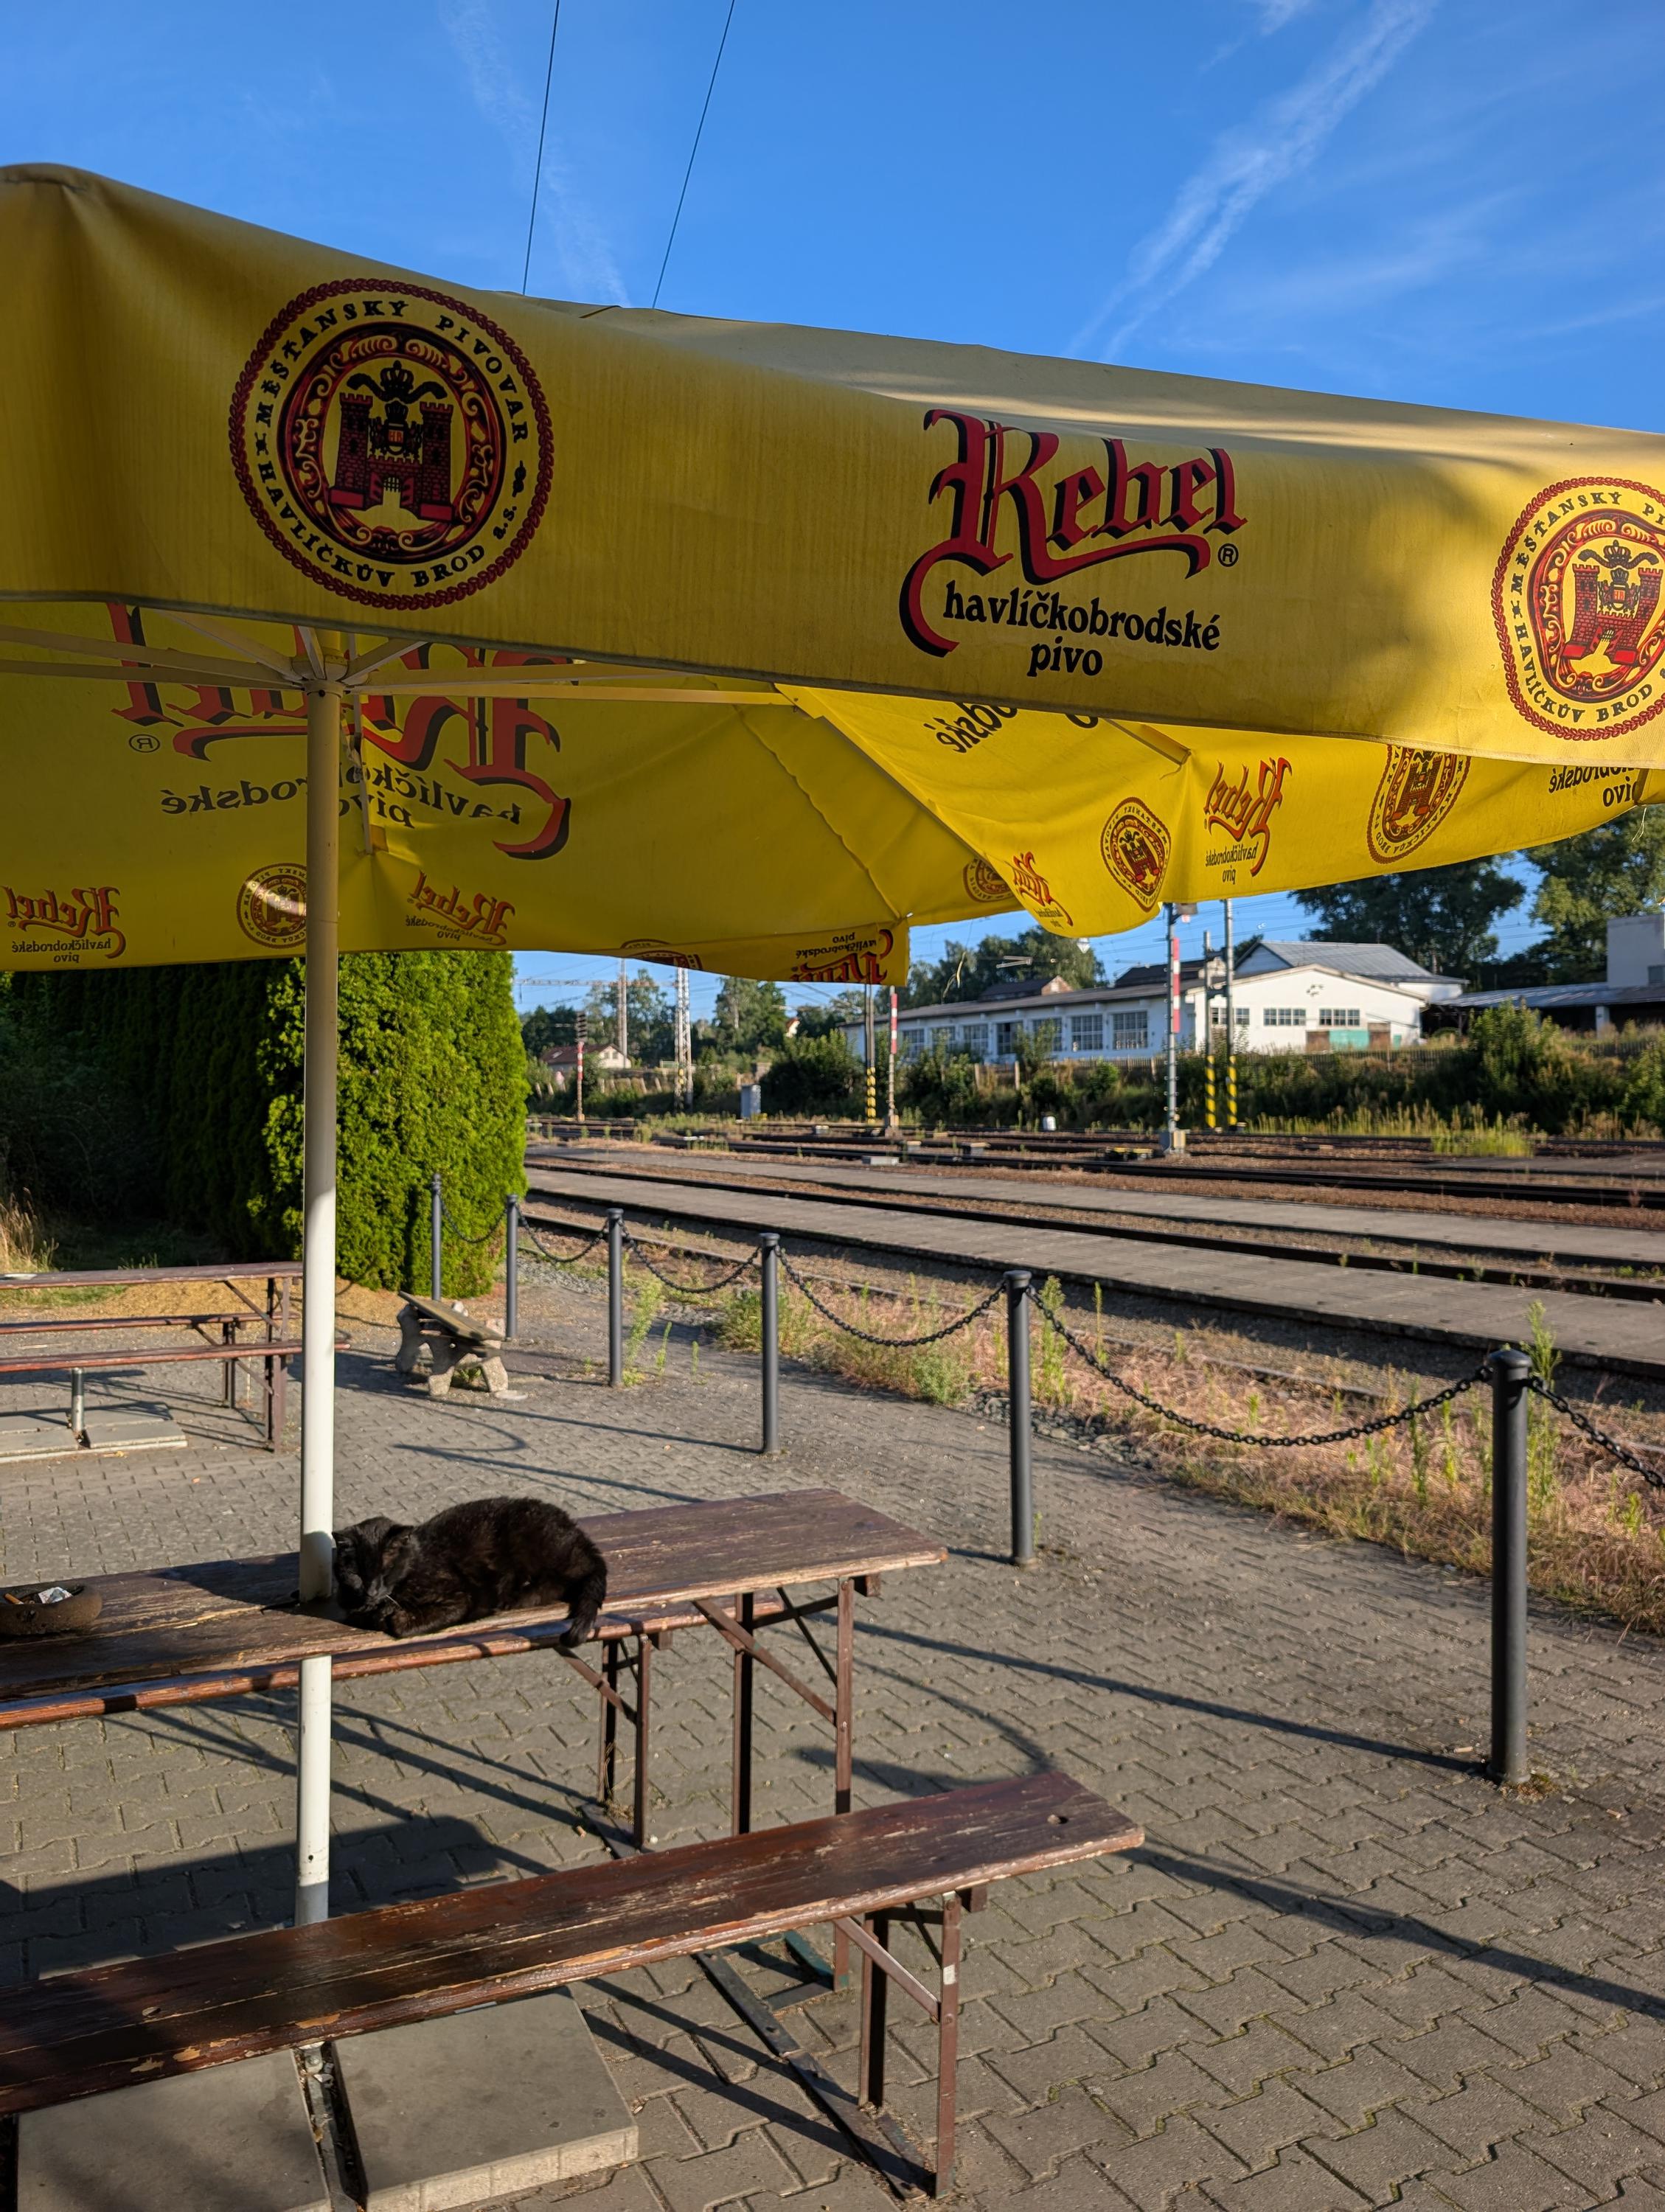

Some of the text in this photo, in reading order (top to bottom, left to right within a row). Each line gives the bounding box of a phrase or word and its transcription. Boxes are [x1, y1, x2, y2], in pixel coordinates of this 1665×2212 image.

[436, 315, 529, 442] PIVOVAR
[257, 460, 518, 588] HAVLÍČKŮV BROD a.s.
[899, 408, 1248, 657] Rebel
[943, 580, 1220, 650] havlíčkobrodské
[1026, 636, 1103, 678] pivo
[1515, 622, 1653, 723] HAVLÍČKŮV BROD
